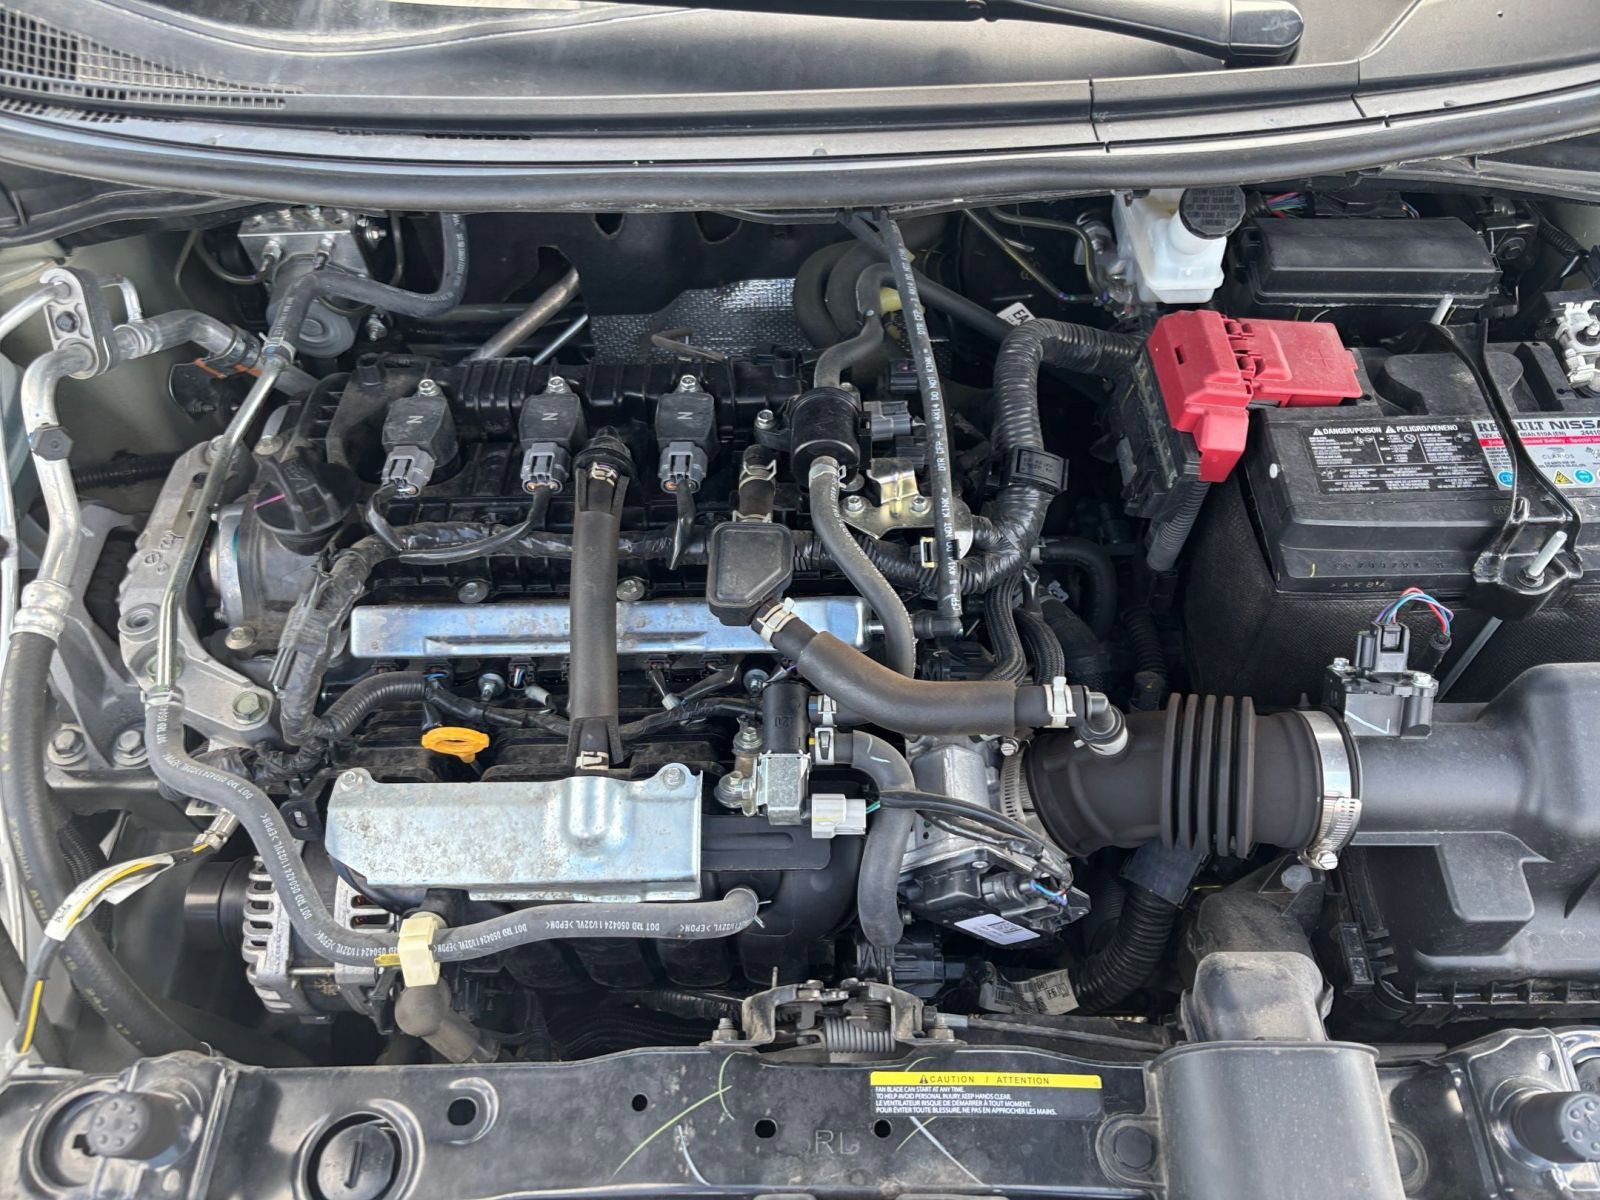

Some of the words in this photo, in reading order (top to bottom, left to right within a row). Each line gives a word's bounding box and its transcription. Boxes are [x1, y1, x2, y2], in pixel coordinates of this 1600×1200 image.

[927, 375, 937, 389] NOT
[929, 391, 939, 401] DO
[1478, 421, 1544, 432] REULT
[1549, 420, 1600, 430] NISS
[941, 496, 951, 518] KINK
[944, 522, 953, 537] NOT
[646, 921, 660, 930] DOT
[930, 1075, 974, 1084] CAUTION
[996, 1076, 1050, 1084] ATTENTION
